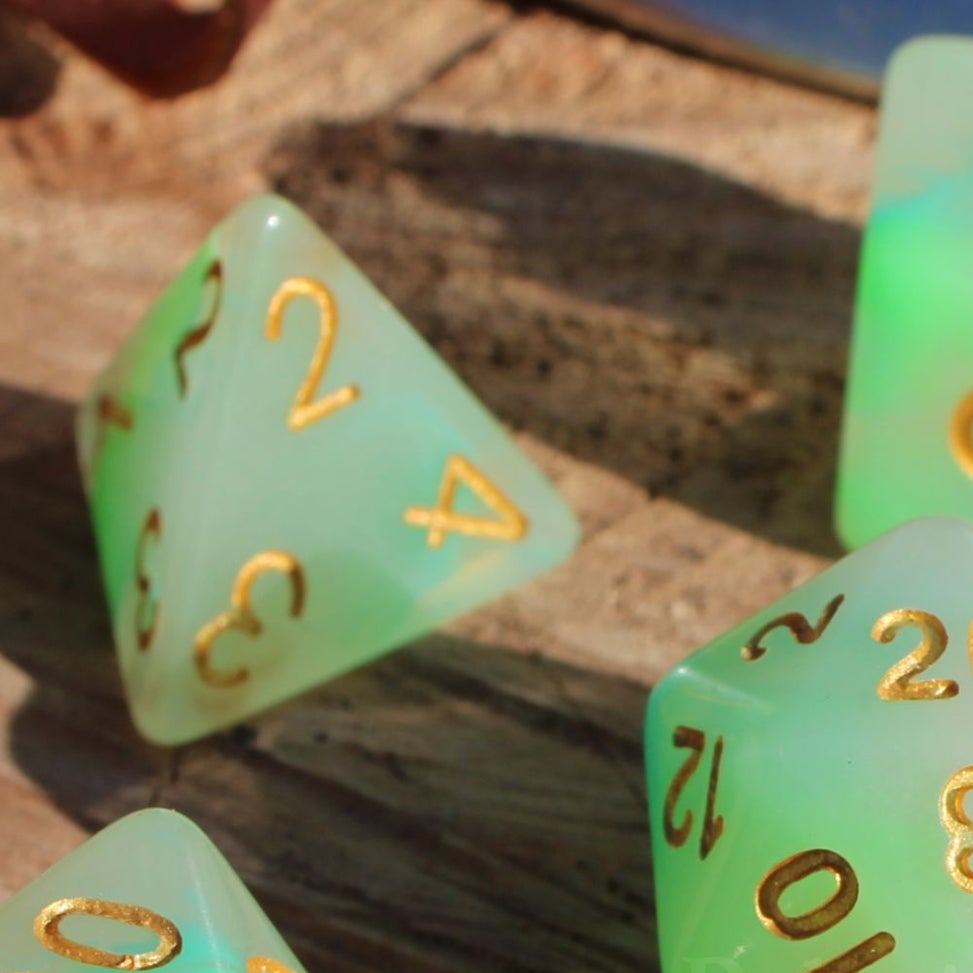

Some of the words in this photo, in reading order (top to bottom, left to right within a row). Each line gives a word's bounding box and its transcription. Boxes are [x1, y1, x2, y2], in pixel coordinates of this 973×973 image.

[265, 277, 360, 431] 2
[404, 453, 529, 548] 4
[195, 550, 307, 688] 3
[740, 594, 844, 661] 2
[663, 725, 724, 860] 12
